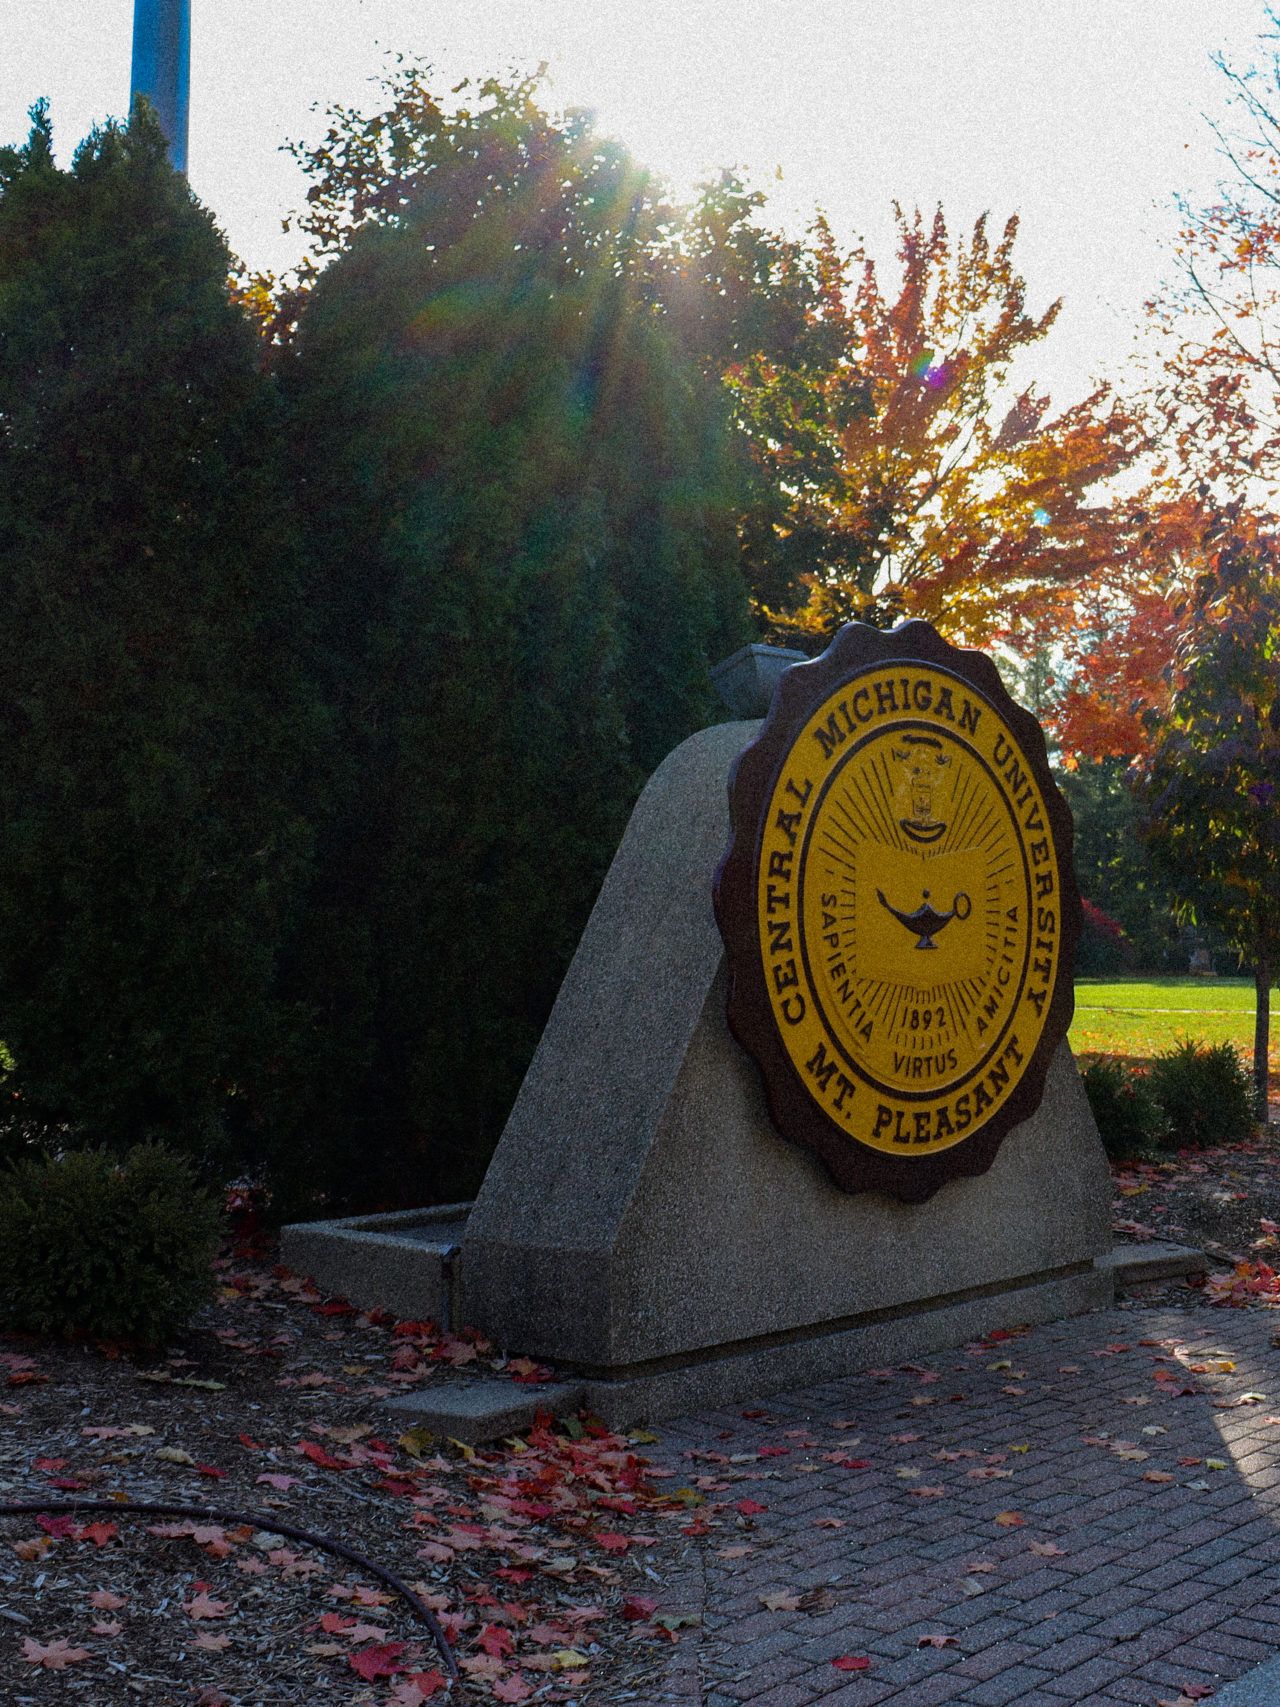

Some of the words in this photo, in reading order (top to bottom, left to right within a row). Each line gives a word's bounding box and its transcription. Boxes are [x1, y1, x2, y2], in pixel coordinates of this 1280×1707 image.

[767, 778, 814, 1026] CENTRAL
[813, 678, 983, 757] MICHIGAN
[992, 733, 1057, 1019] UNIVERSITY
[822, 892, 874, 1044] SAPIENTIA
[893, 1048, 958, 1078] VIRTUS
[976, 906, 1019, 1037] AMICITIA
[902, 1006, 947, 1030] 1892
[806, 1043, 857, 1120] MT.
[873, 1036, 1025, 1144] PLEASANT
